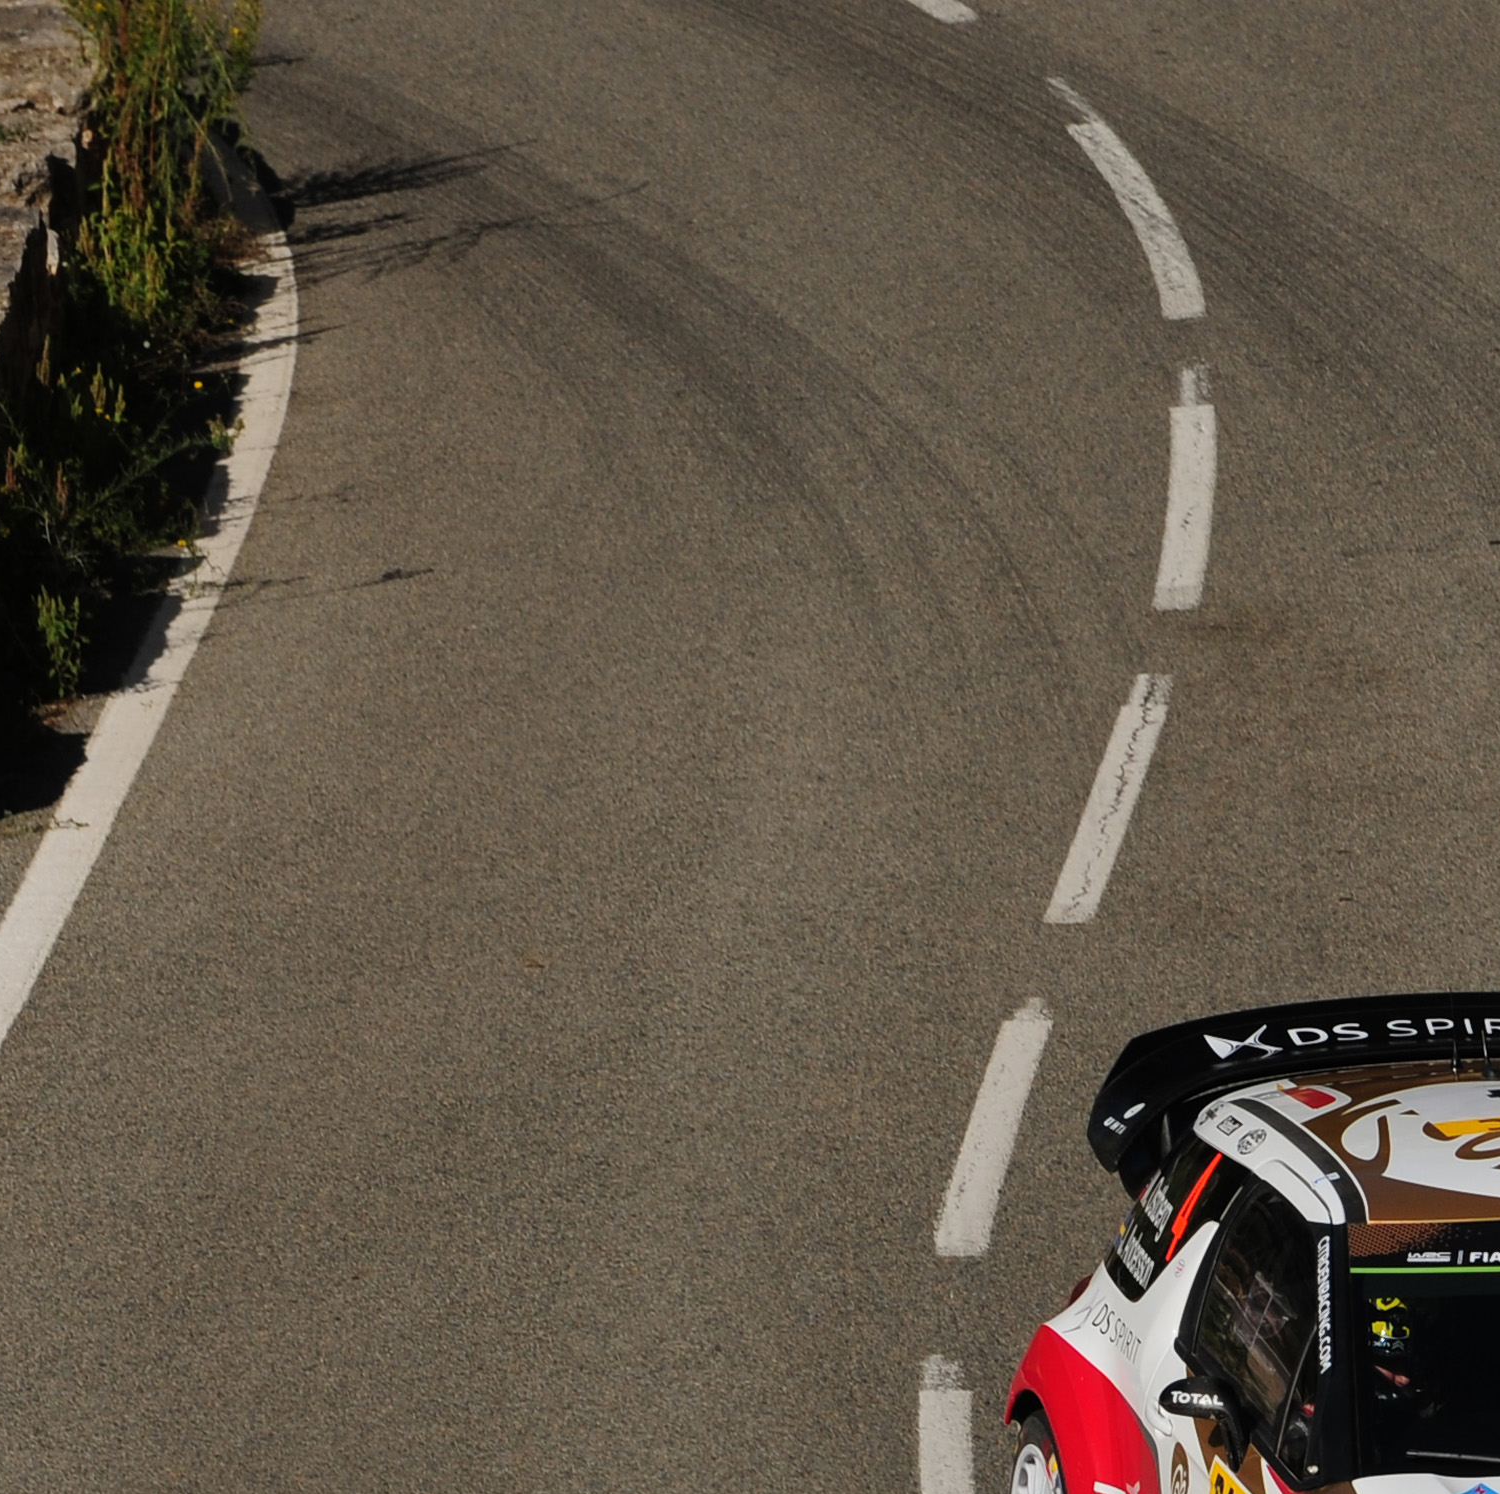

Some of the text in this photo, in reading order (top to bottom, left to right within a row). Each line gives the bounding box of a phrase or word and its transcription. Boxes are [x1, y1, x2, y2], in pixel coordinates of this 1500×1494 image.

[1287, 1023, 1369, 1046] DS
[1092, 1303, 1141, 1364] DS SPIRIT
[1171, 1390, 1224, 1406] TOTAL
